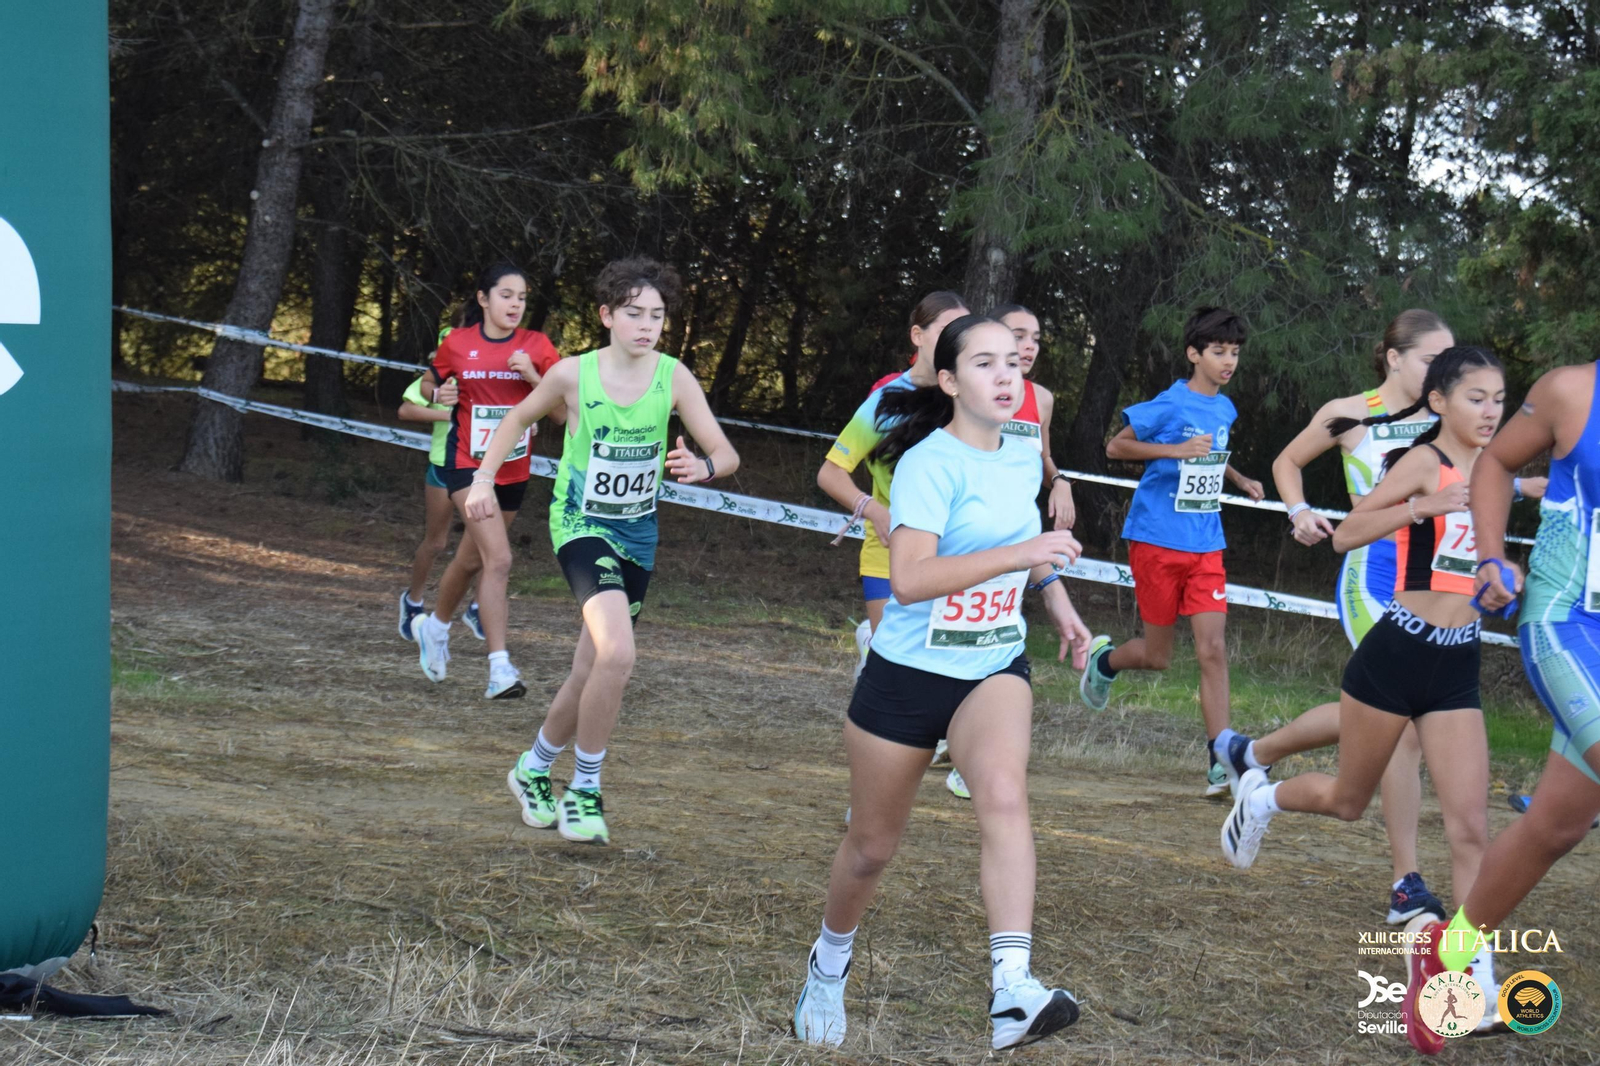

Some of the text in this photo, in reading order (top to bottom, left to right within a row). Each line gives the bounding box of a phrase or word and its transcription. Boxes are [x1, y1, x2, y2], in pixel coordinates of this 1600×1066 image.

[462, 371, 486, 380] SAN
[613, 425, 657, 435] Fundación
[613, 435, 646, 443] Unicaja
[614, 447, 651, 458] ITÁLICA
[593, 470, 656, 497] 8042
[1184, 474, 1220, 495] 5836
[737, 506, 757, 516] Sevilla
[798, 518, 818, 528] Sevilla
[943, 587, 1018, 623] 5354
[1386, 600, 1426, 635] PRO
[1426, 622, 1475, 645] NIKE
